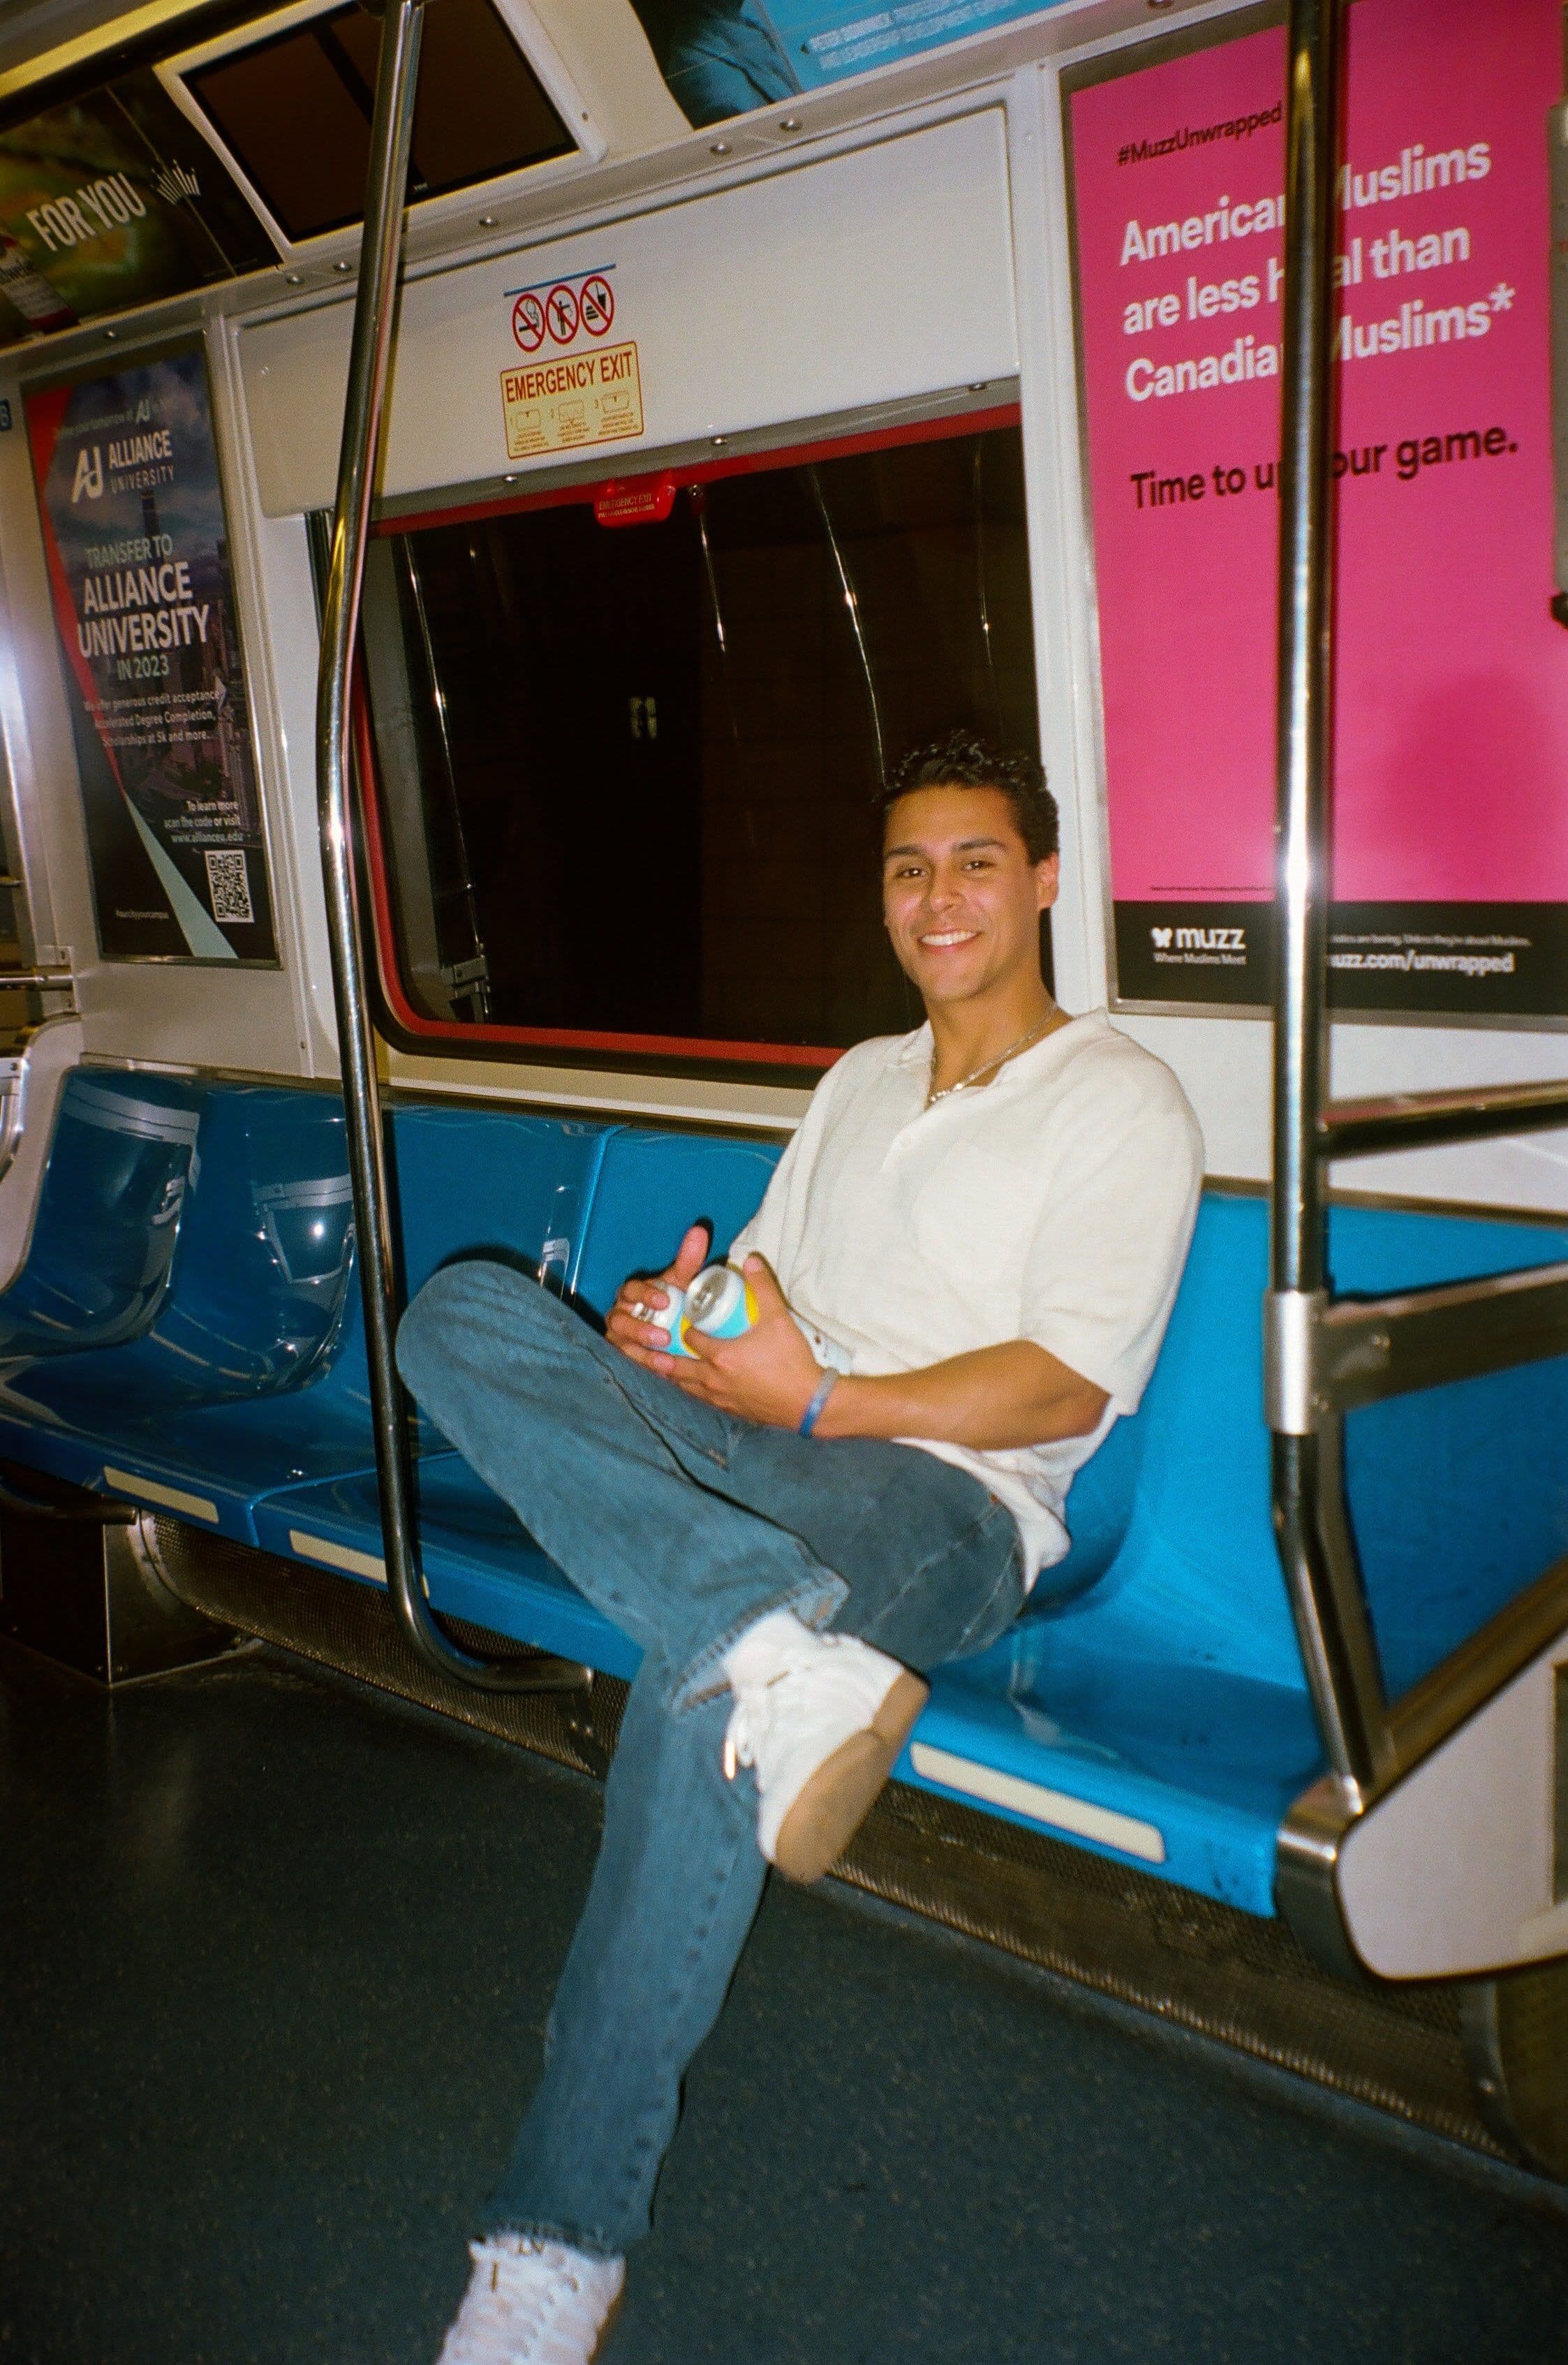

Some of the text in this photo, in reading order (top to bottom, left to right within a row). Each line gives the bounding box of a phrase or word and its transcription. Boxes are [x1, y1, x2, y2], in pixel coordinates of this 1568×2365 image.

[1118, 101, 1283, 166] #MuzzUnwrapped
[27, 172, 147, 252] FOR YOU
[1123, 293, 1181, 334] are
[1187, 276, 1259, 321] less
[1370, 228, 1470, 279] than
[505, 351, 633, 403] EMERGENCY EXIT
[1125, 334, 1283, 402] Canadia
[108, 429, 174, 471] ALLIANCE
[1130, 470, 1206, 508] Time
[1212, 464, 1245, 496] to
[1329, 443, 1387, 480] our
[1396, 425, 1519, 481] game.
[109, 464, 175, 494] UNIVERSITY
[84, 533, 174, 570] TRANSFER TO
[84, 561, 193, 615] ALLIANCE
[77, 604, 209, 658] UNIVERSITY
[116, 654, 170, 681] IN 2023
[135, 714, 163, 728] Degree
[147, 693, 172, 706] credit
[1176, 927, 1246, 950] muzz
[1329, 949, 1515, 976] uzz.com/unwrapped
